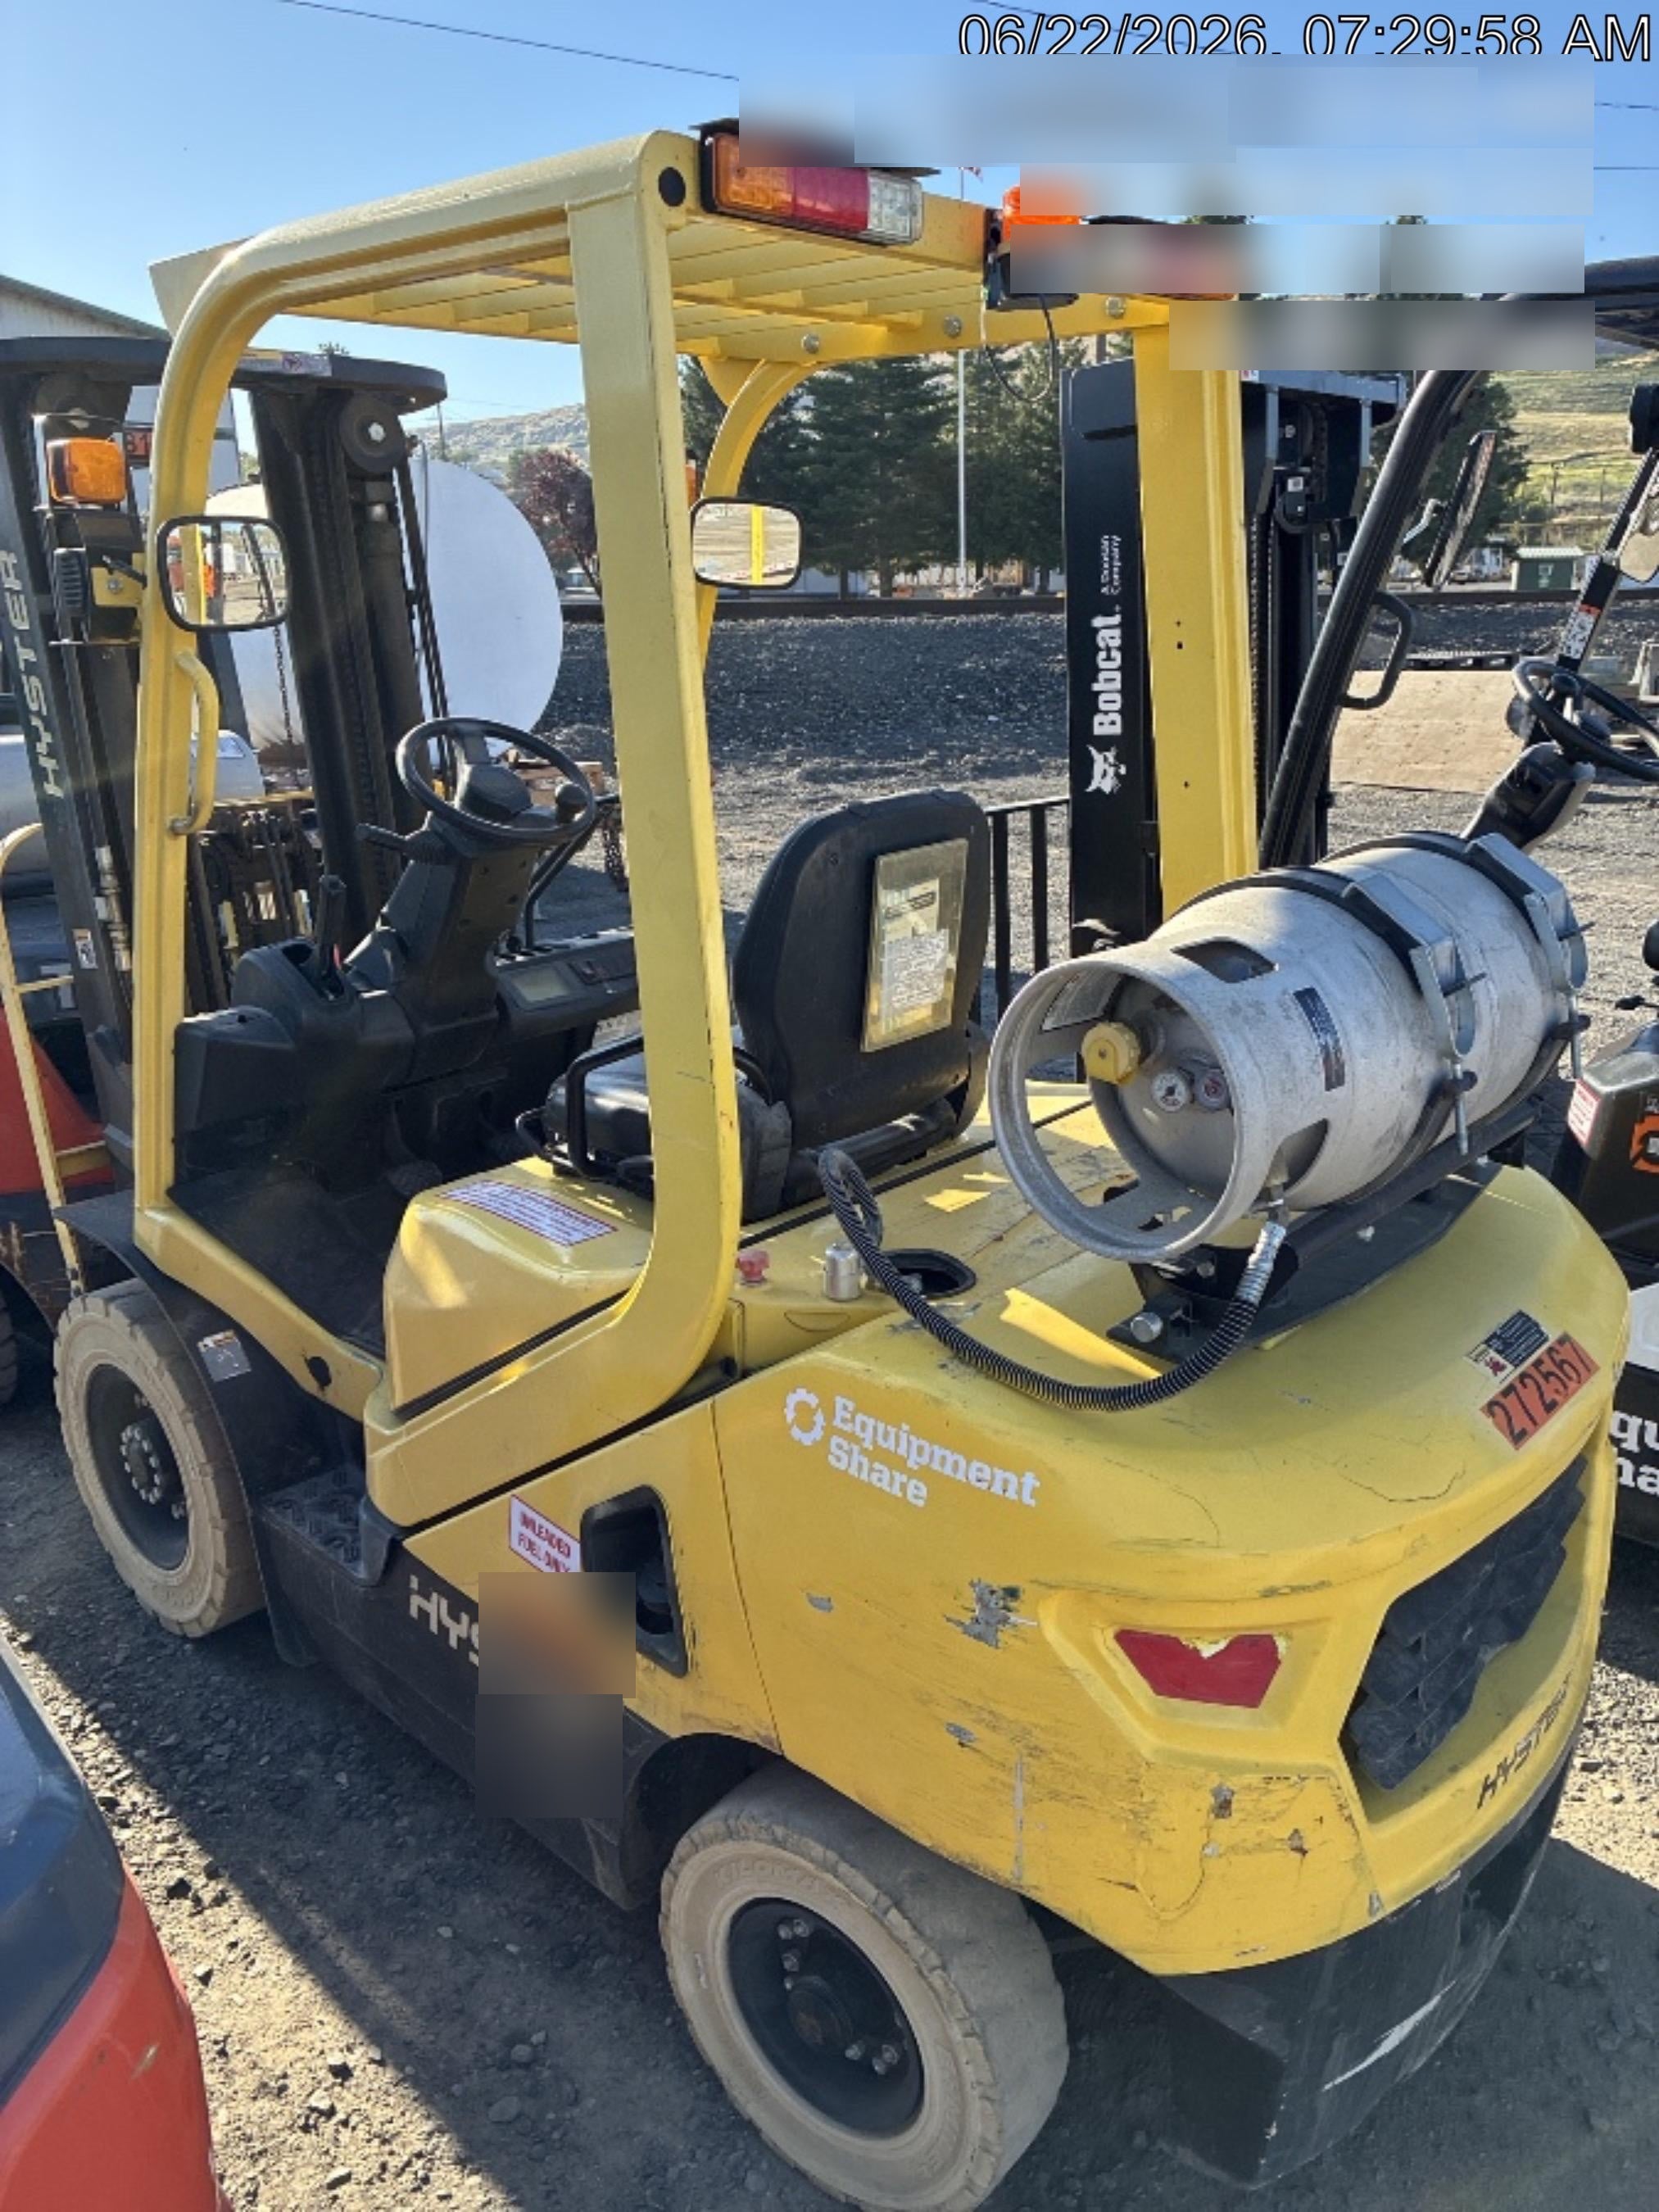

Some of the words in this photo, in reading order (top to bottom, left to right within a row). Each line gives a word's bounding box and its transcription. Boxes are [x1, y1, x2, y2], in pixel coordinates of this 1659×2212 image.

[0, 550, 65, 799] HYSTER
[1091, 613, 1122, 736] Bobcat
[1486, 1329, 1593, 1448] 272567
[827, 1435, 927, 1507] Share
[832, 1395, 1040, 1507] Equipment
